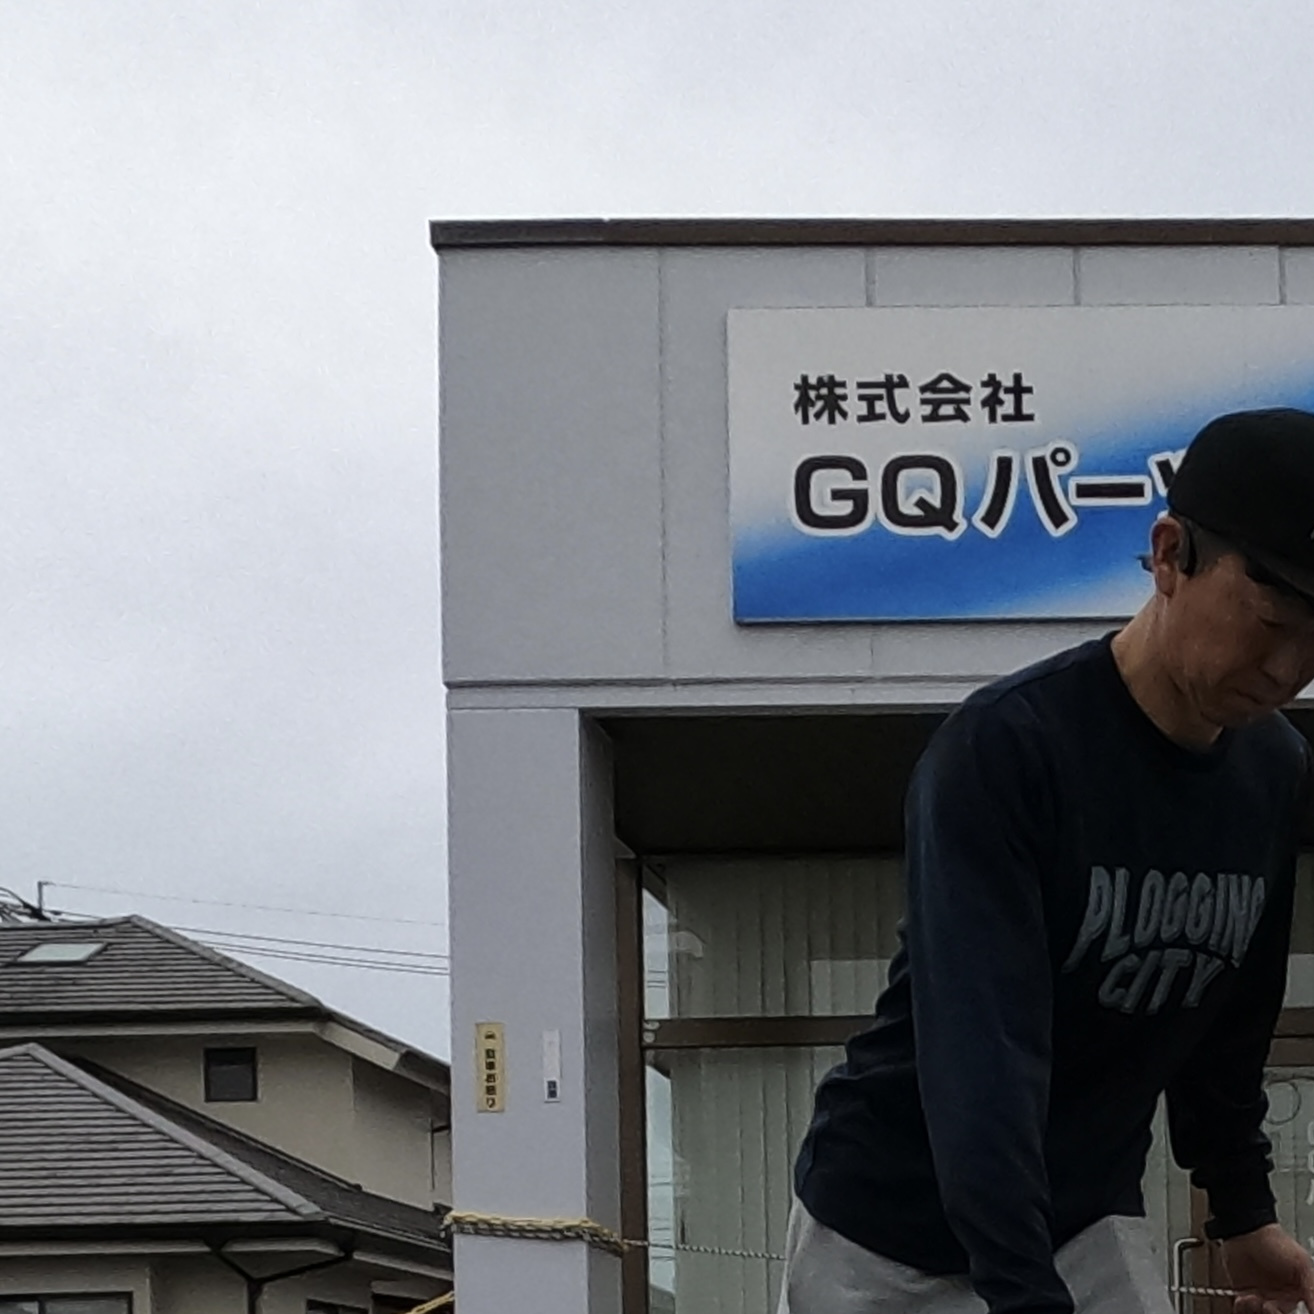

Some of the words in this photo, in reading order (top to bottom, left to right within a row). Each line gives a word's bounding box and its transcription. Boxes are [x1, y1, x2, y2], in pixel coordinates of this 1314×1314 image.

[794, 372, 1036, 424] 株式会社
[1099, 949, 1225, 1015] CITY
